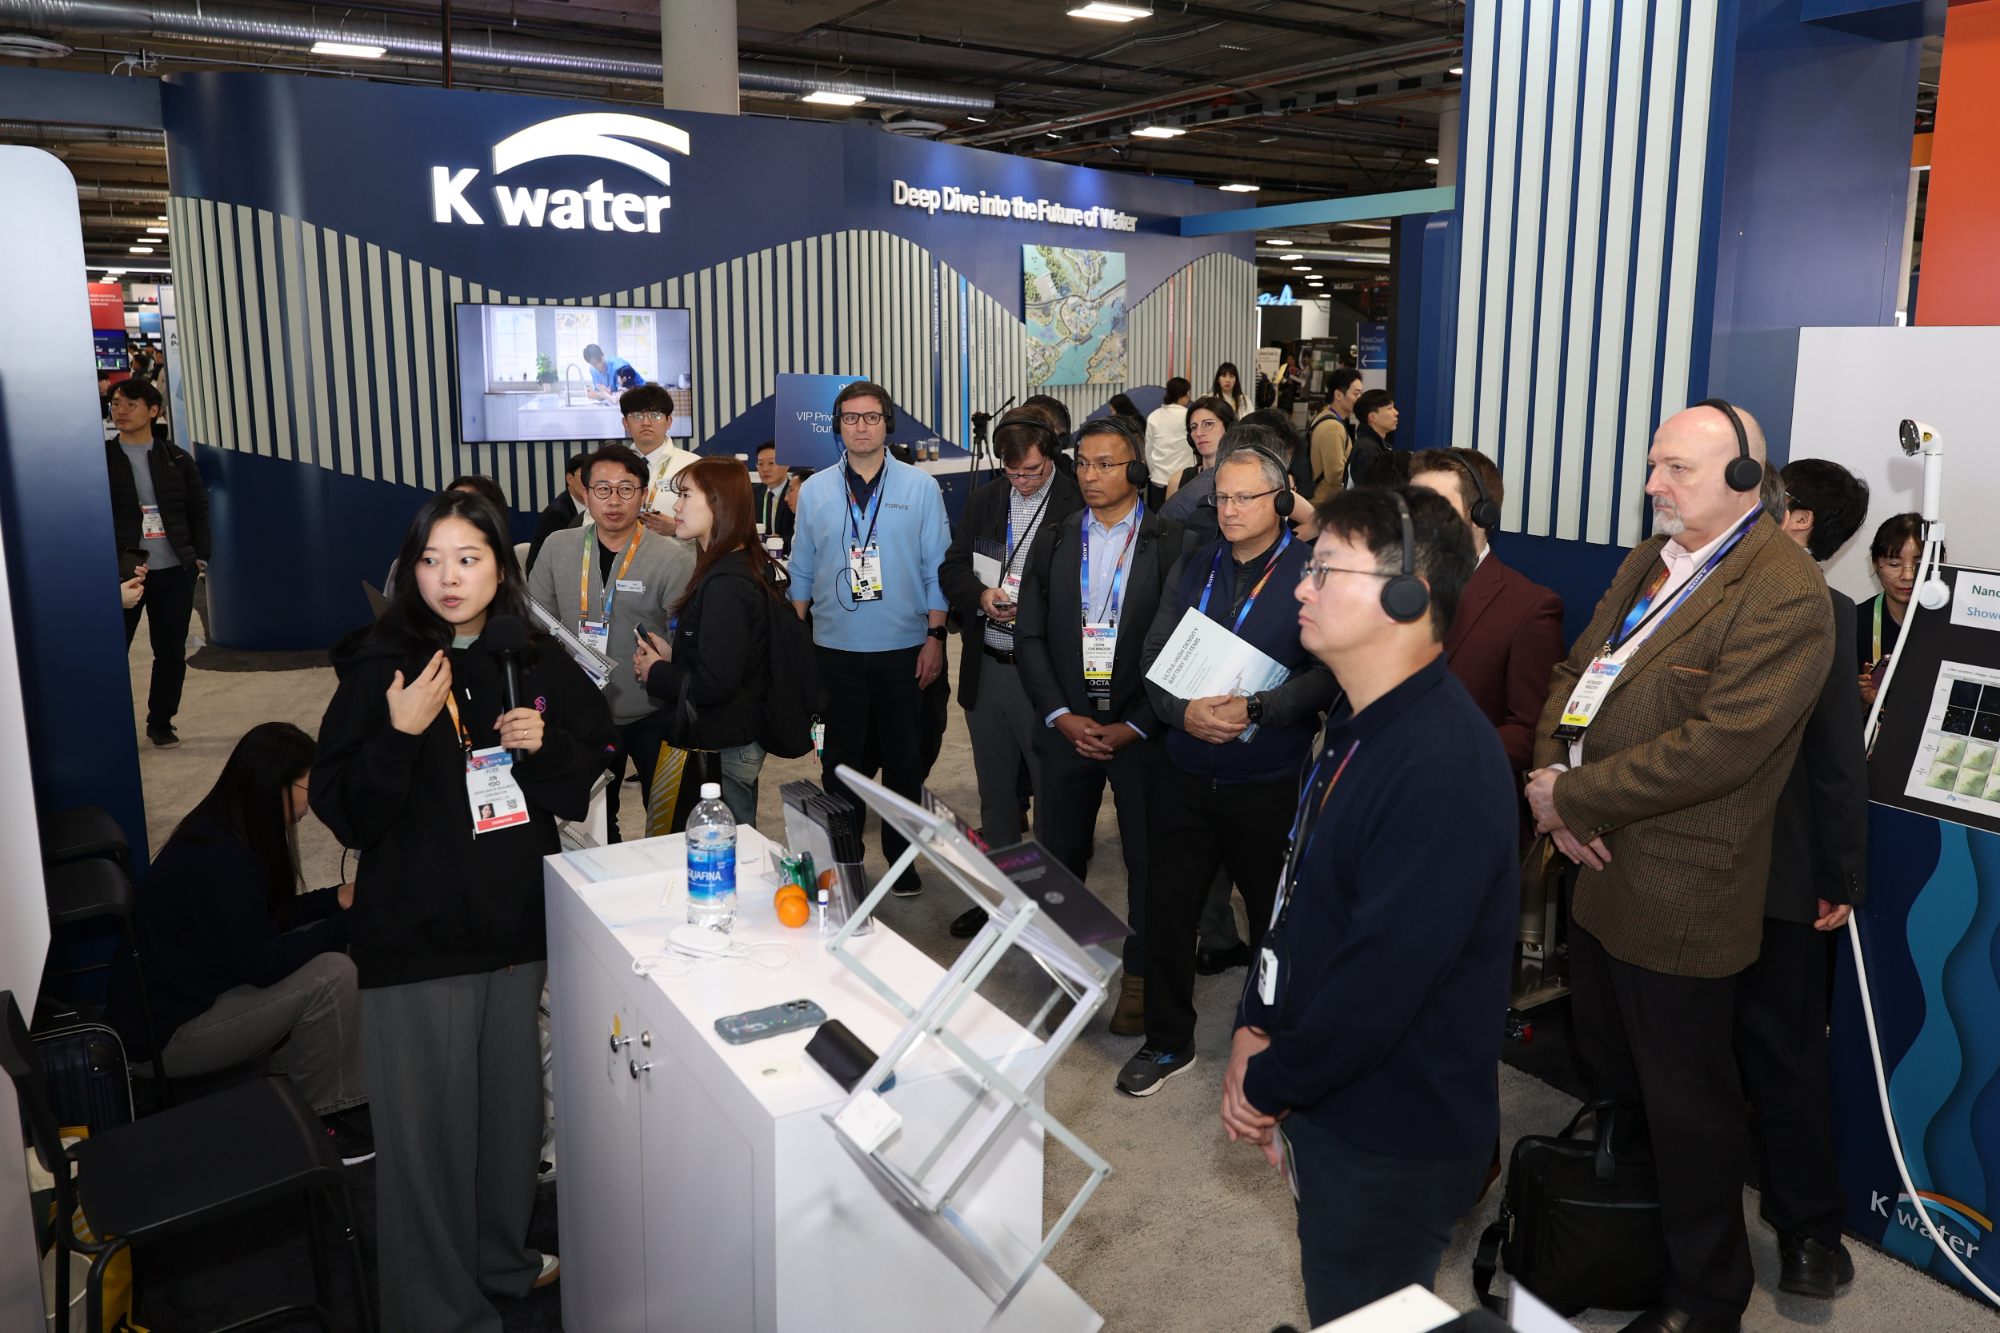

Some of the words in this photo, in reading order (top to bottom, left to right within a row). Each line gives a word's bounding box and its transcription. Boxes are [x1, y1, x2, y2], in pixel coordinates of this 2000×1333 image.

[429, 166, 485, 225] K
[491, 179, 671, 233] water
[893, 179, 940, 215] Deep
[942, 186, 979, 214] Dive
[980, 190, 1010, 218] into
[1011, 196, 1038, 220] the
[1038, 199, 1084, 226] Future
[1084, 206, 1100, 228] of
[1100, 207, 1138, 232] Water
[796, 411, 813, 421] VIP
[815, 412, 834, 422] Priv
[811, 423, 832, 433] Tour
[1207, 570, 1215, 588] SONY
[1688, 569, 1707, 591] SONY
[1967, 606, 2000, 620] Show
[1163, 648, 1186, 681] ULTRA-HIGH
[1183, 627, 1199, 650] DENSITY
[1168, 660, 1185, 685] BATTERY
[1184, 637, 1200, 662] SYSTEMS
[688, 868, 722, 881] QUAFINA
[1871, 1190, 1889, 1218] K
